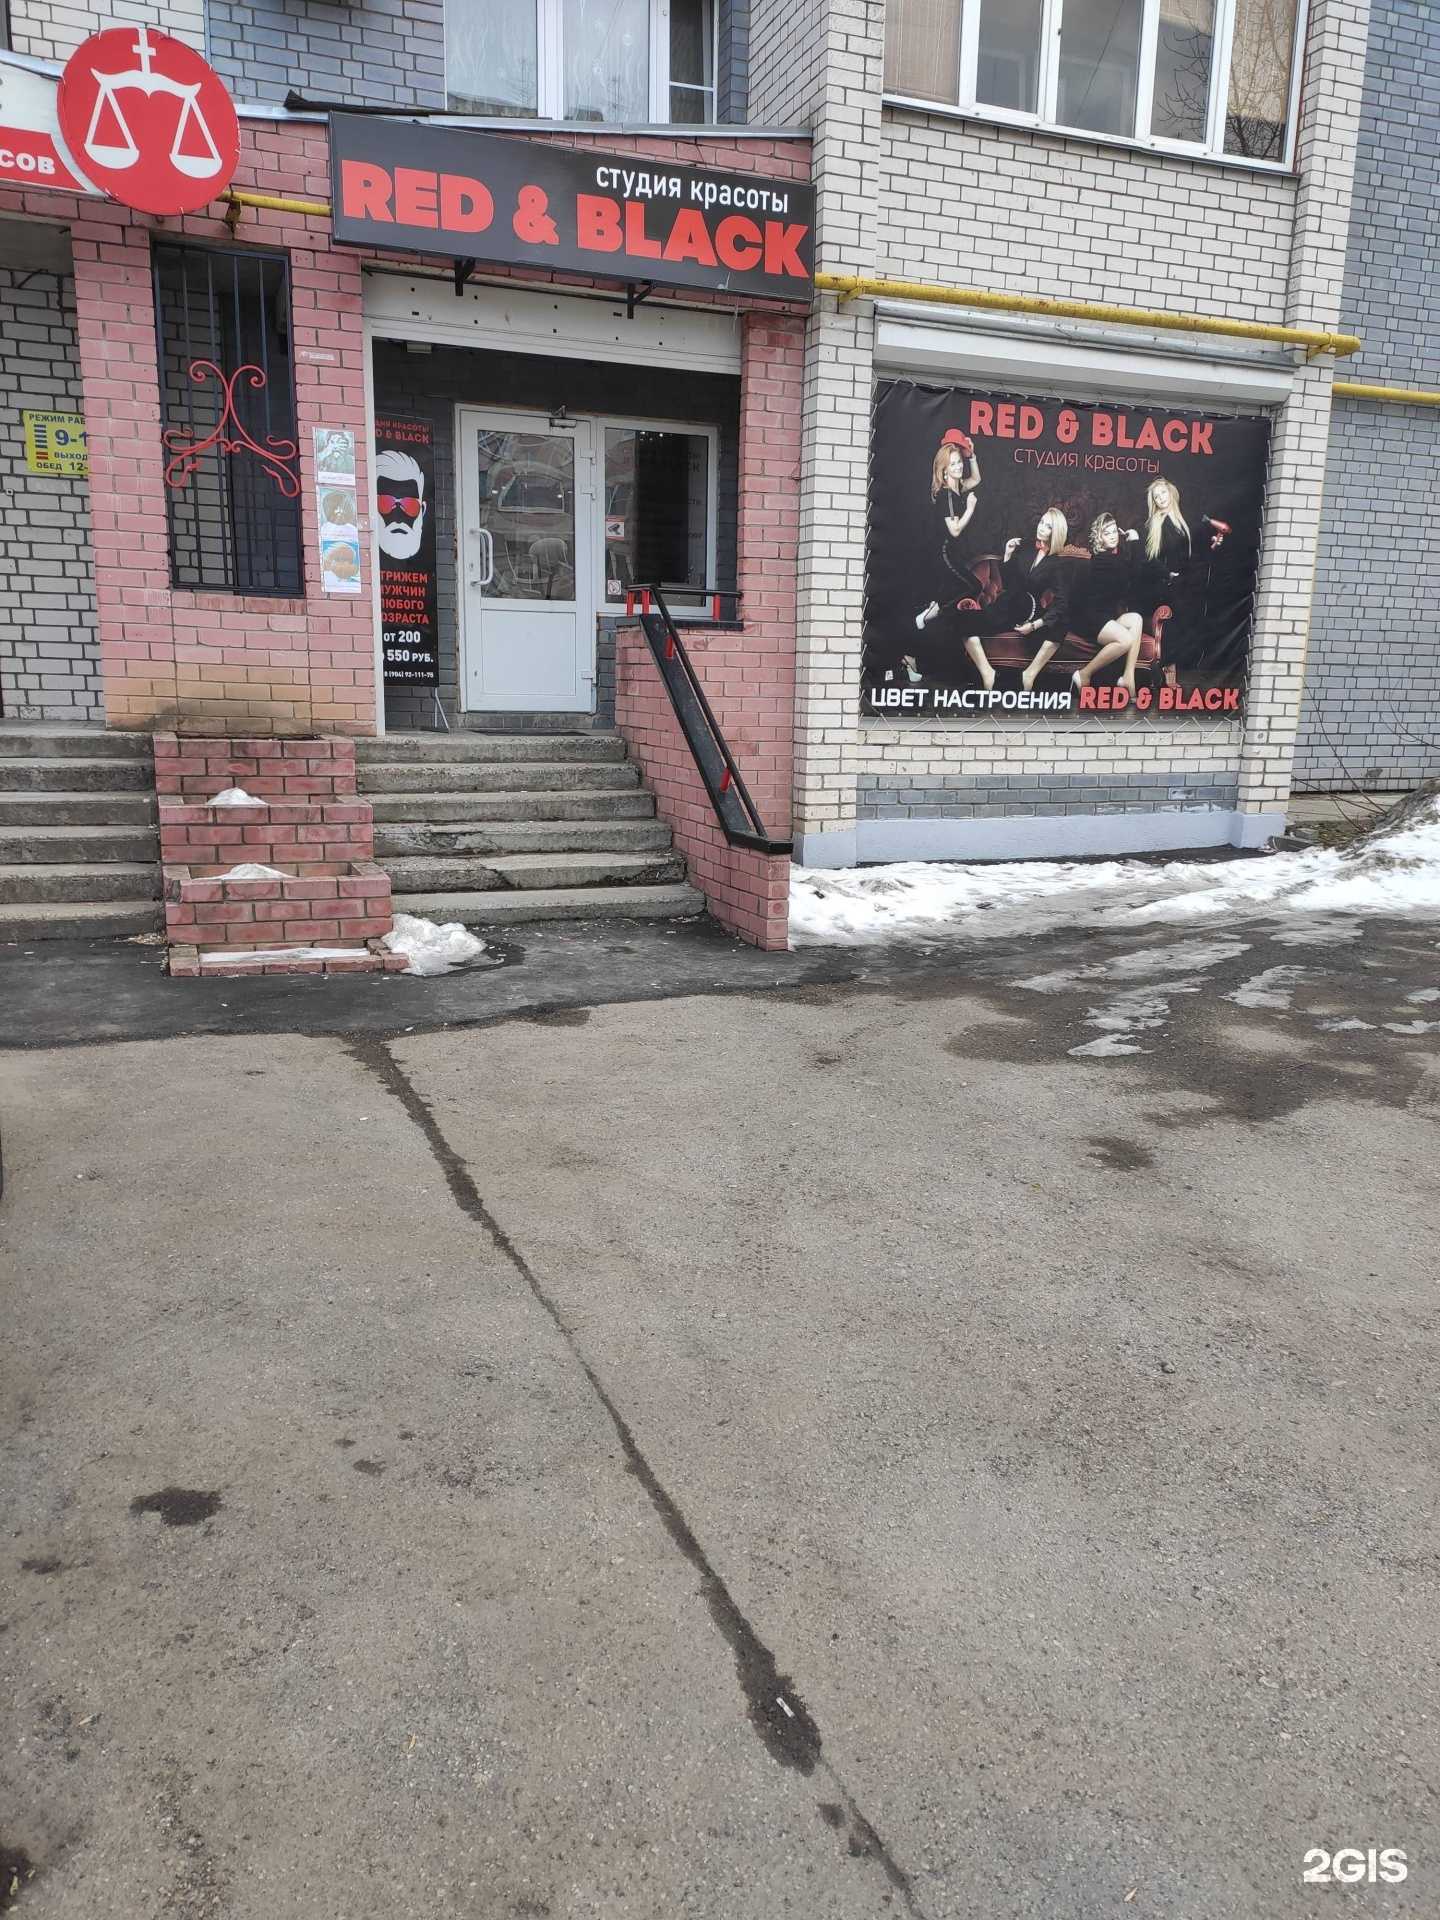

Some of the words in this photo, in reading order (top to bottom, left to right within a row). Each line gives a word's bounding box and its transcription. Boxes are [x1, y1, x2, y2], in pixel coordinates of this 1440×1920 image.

[596, 166, 682, 198] студия
[690, 180, 789, 214] красоты
[341, 159, 495, 234] RED
[512, 184, 560, 246] &
[576, 192, 809, 279] BLACK
[28, 413, 65, 423] РЕЖИМ
[969, 400, 1044, 440] RED
[1056, 409, 1080, 444] &
[1091, 410, 1214, 455] BLACK
[54, 429, 88, 448] 9-1
[395, 430, 431, 444] BLACK
[1014, 448, 1078, 469] студия
[1084, 453, 1160, 473] красоты
[380, 570, 428, 584] ТРИЖЕМ
[381, 584, 426, 598] УЖЧИН
[382, 612, 430, 625] ОЗРАСТА
[398, 630, 421, 643] 200
[386, 648, 410, 662] 550
[871, 687, 929, 707] ЦВЕТ
[933, 689, 1071, 709] НАСТРОЕНИЯ
[1079, 687, 1129, 709] RED
[1136, 690, 1152, 710] &
[1159, 687, 1239, 710] BLACK
